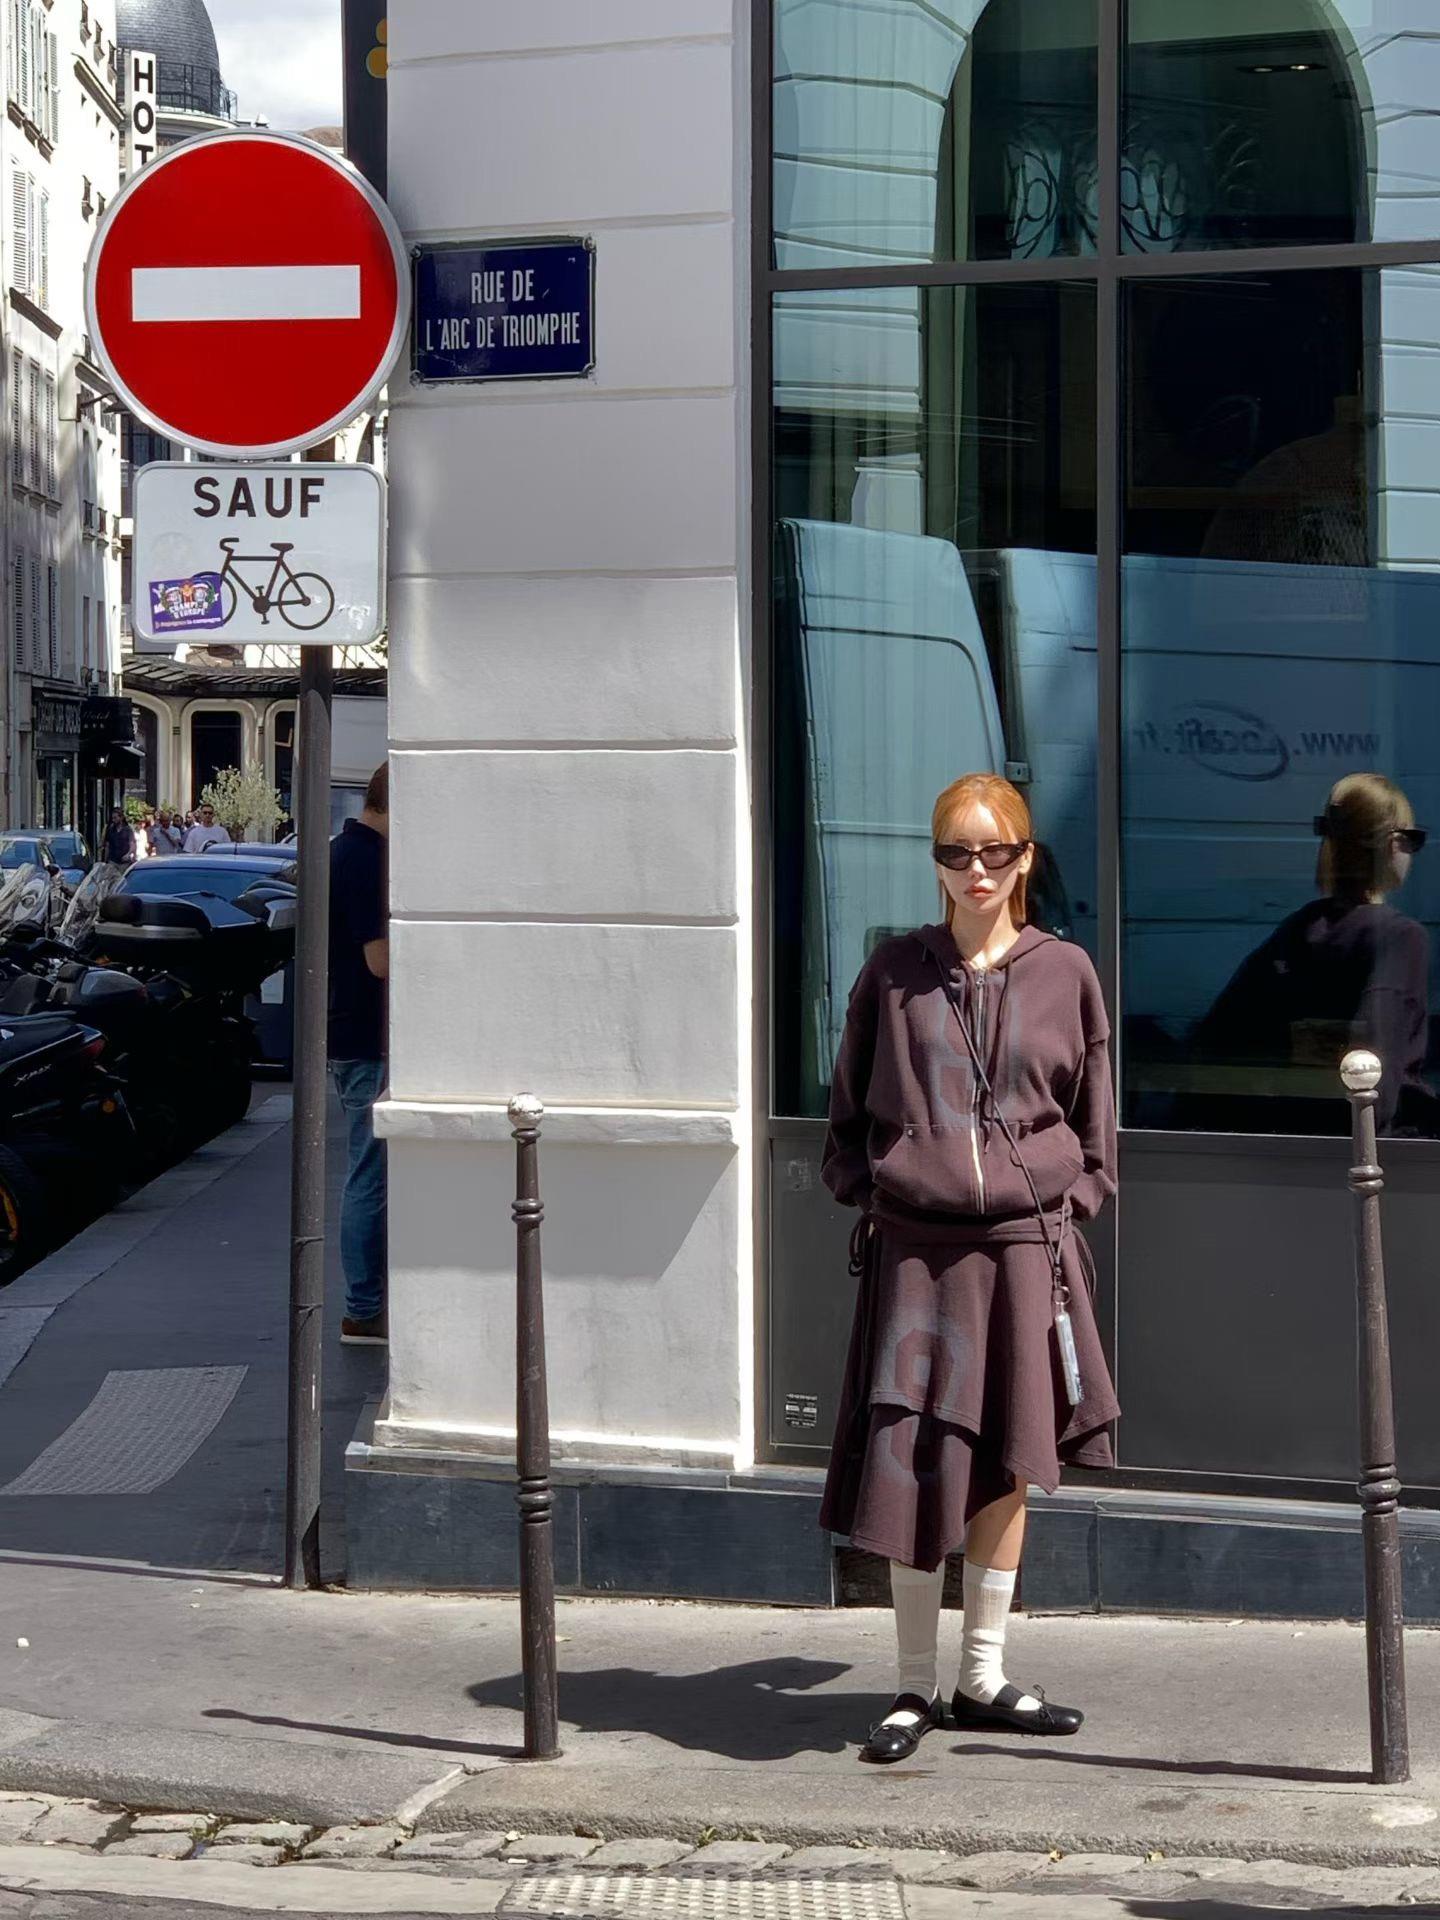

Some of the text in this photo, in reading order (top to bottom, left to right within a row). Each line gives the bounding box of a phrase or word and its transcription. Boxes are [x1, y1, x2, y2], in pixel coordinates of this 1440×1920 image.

[471, 269, 535, 304] RUE DE
[426, 312, 581, 351] L'ARC DE TRIOMPHE
[193, 476, 325, 518] SAUF
